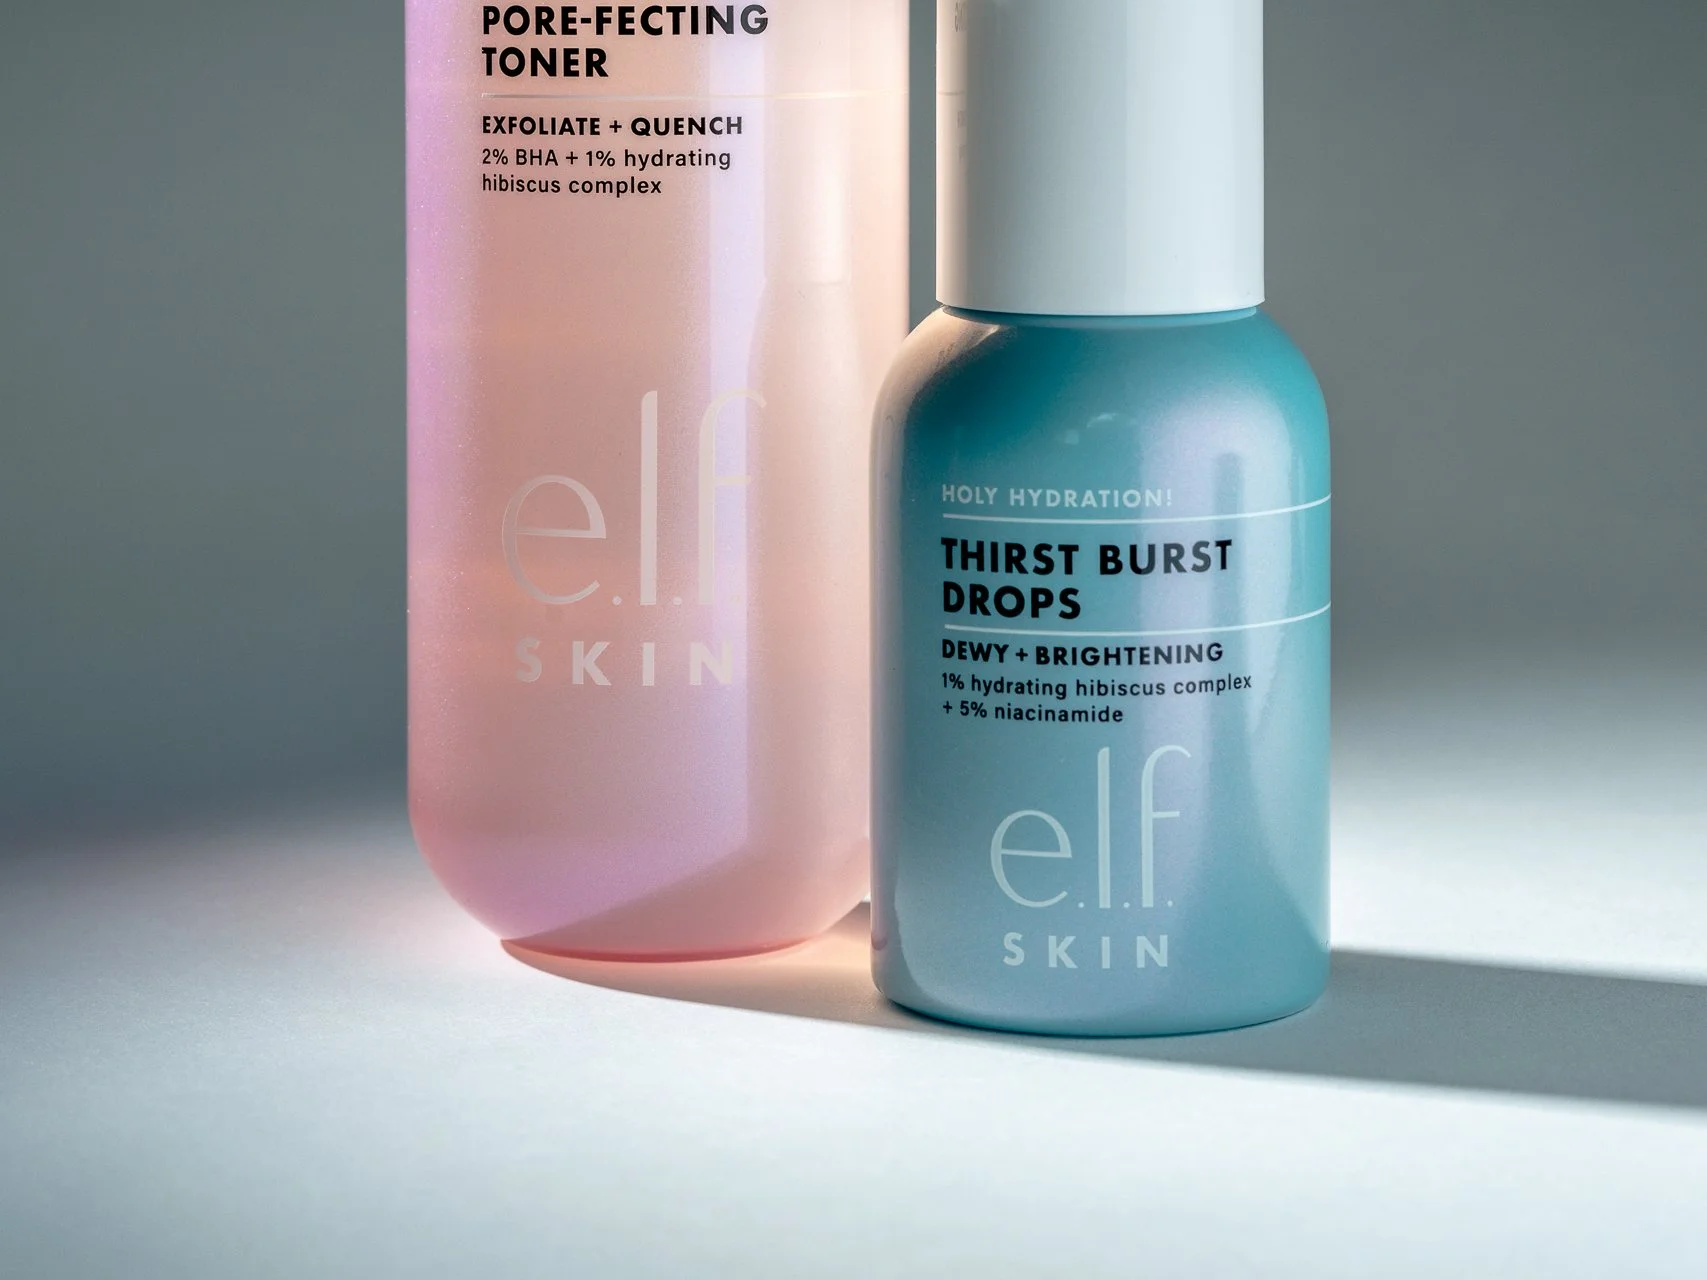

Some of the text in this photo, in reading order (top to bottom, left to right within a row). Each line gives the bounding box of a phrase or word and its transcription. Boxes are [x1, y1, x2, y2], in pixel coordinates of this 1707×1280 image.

[482, 4, 769, 36] PORE-FECTING
[481, 46, 609, 77] TONER
[482, 115, 743, 137] EXFOLIATE + QUENCH
[481, 148, 731, 171] 2% BHA + 1% hydrating
[482, 173, 662, 198] hibiscus complex
[941, 483, 1173, 508] HOLY HYDRATION!
[940, 536, 1233, 576] THIRST BURST
[942, 580, 1081, 620] DROPS
[515, 636, 734, 687] SKIN
[941, 638, 1224, 666] DEWY + BRIGHTENING
[941, 672, 1252, 700] 1% hydrating hibiscus complex
[942, 700, 1124, 723] + 5% niacinamide
[990, 744, 1192, 909] e.l.f.
[1002, 931, 1169, 969] SKIN
